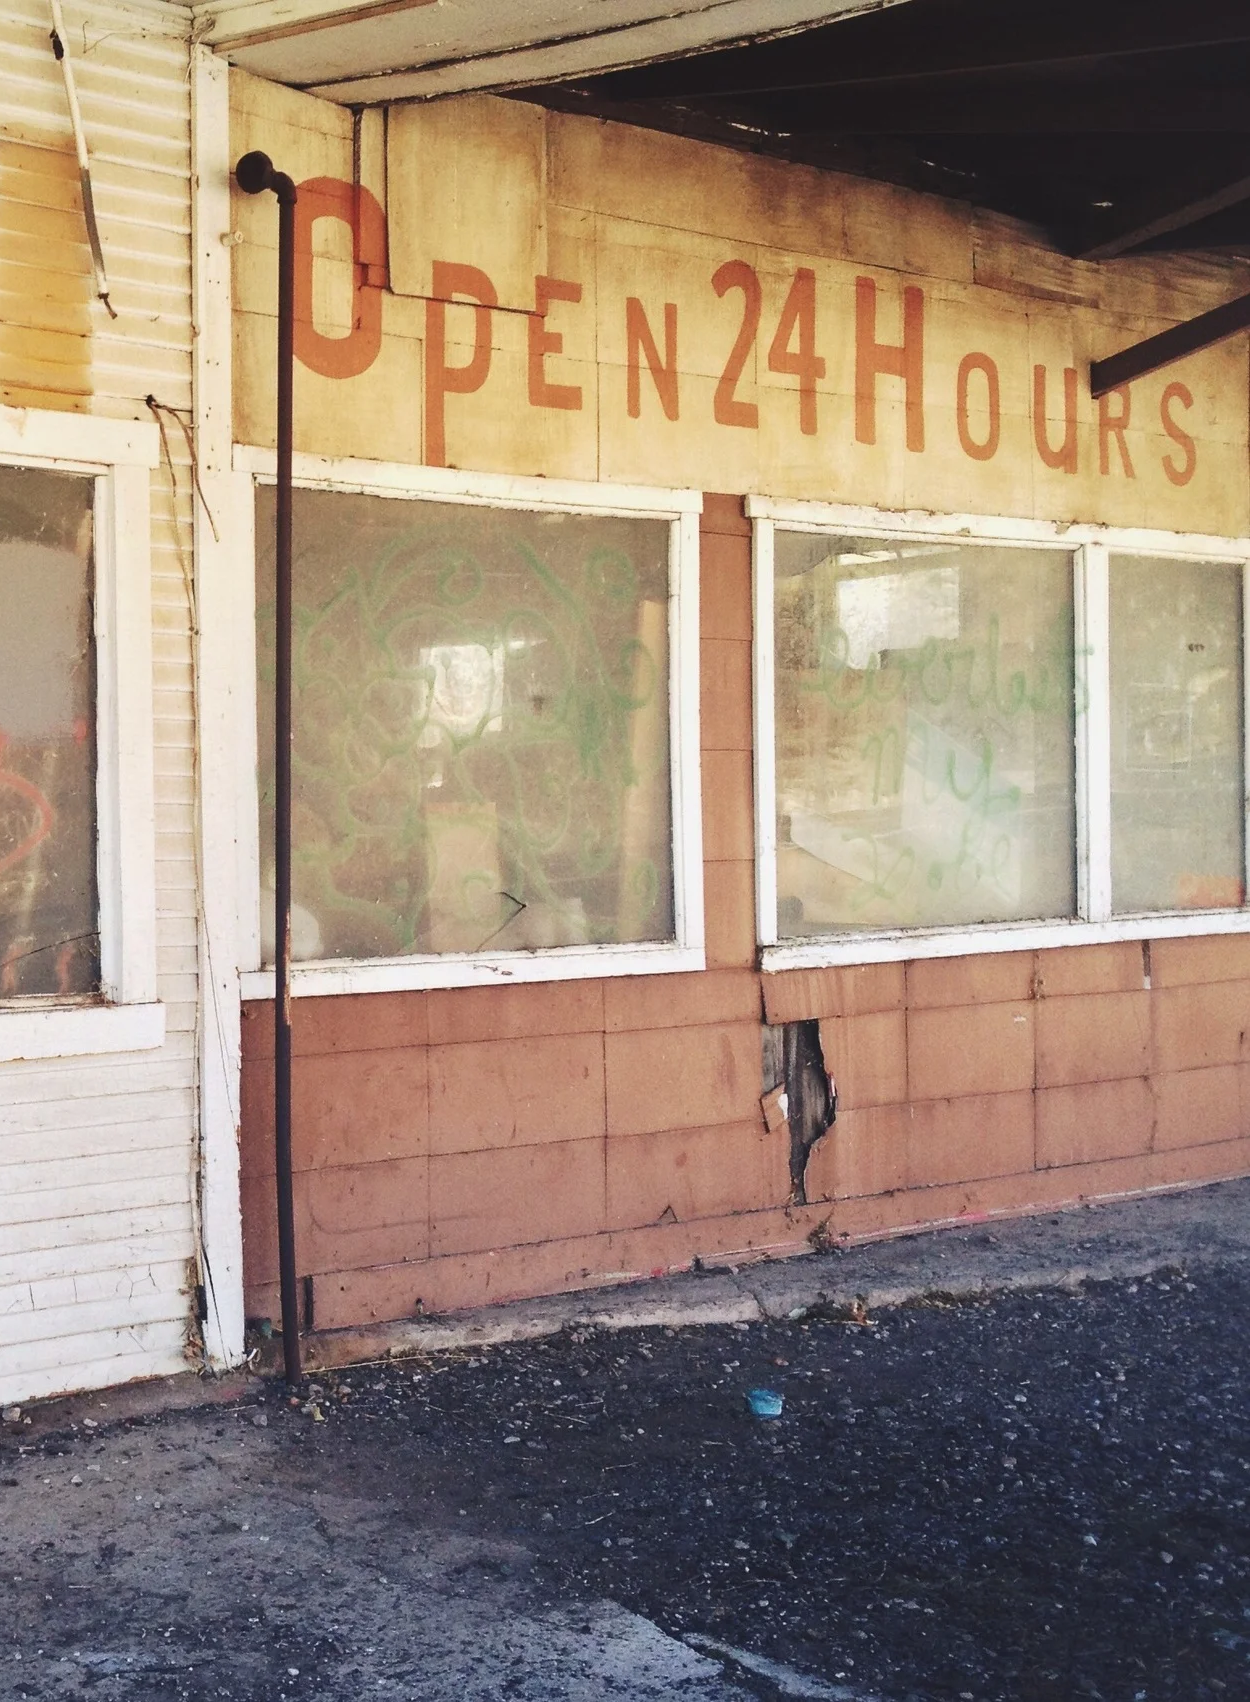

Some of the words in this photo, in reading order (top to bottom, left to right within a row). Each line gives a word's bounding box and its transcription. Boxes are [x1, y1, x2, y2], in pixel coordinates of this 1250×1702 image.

[293, 176, 679, 467] OPEN
[710, 259, 826, 436] 24
[855, 275, 1197, 487] HOURS
